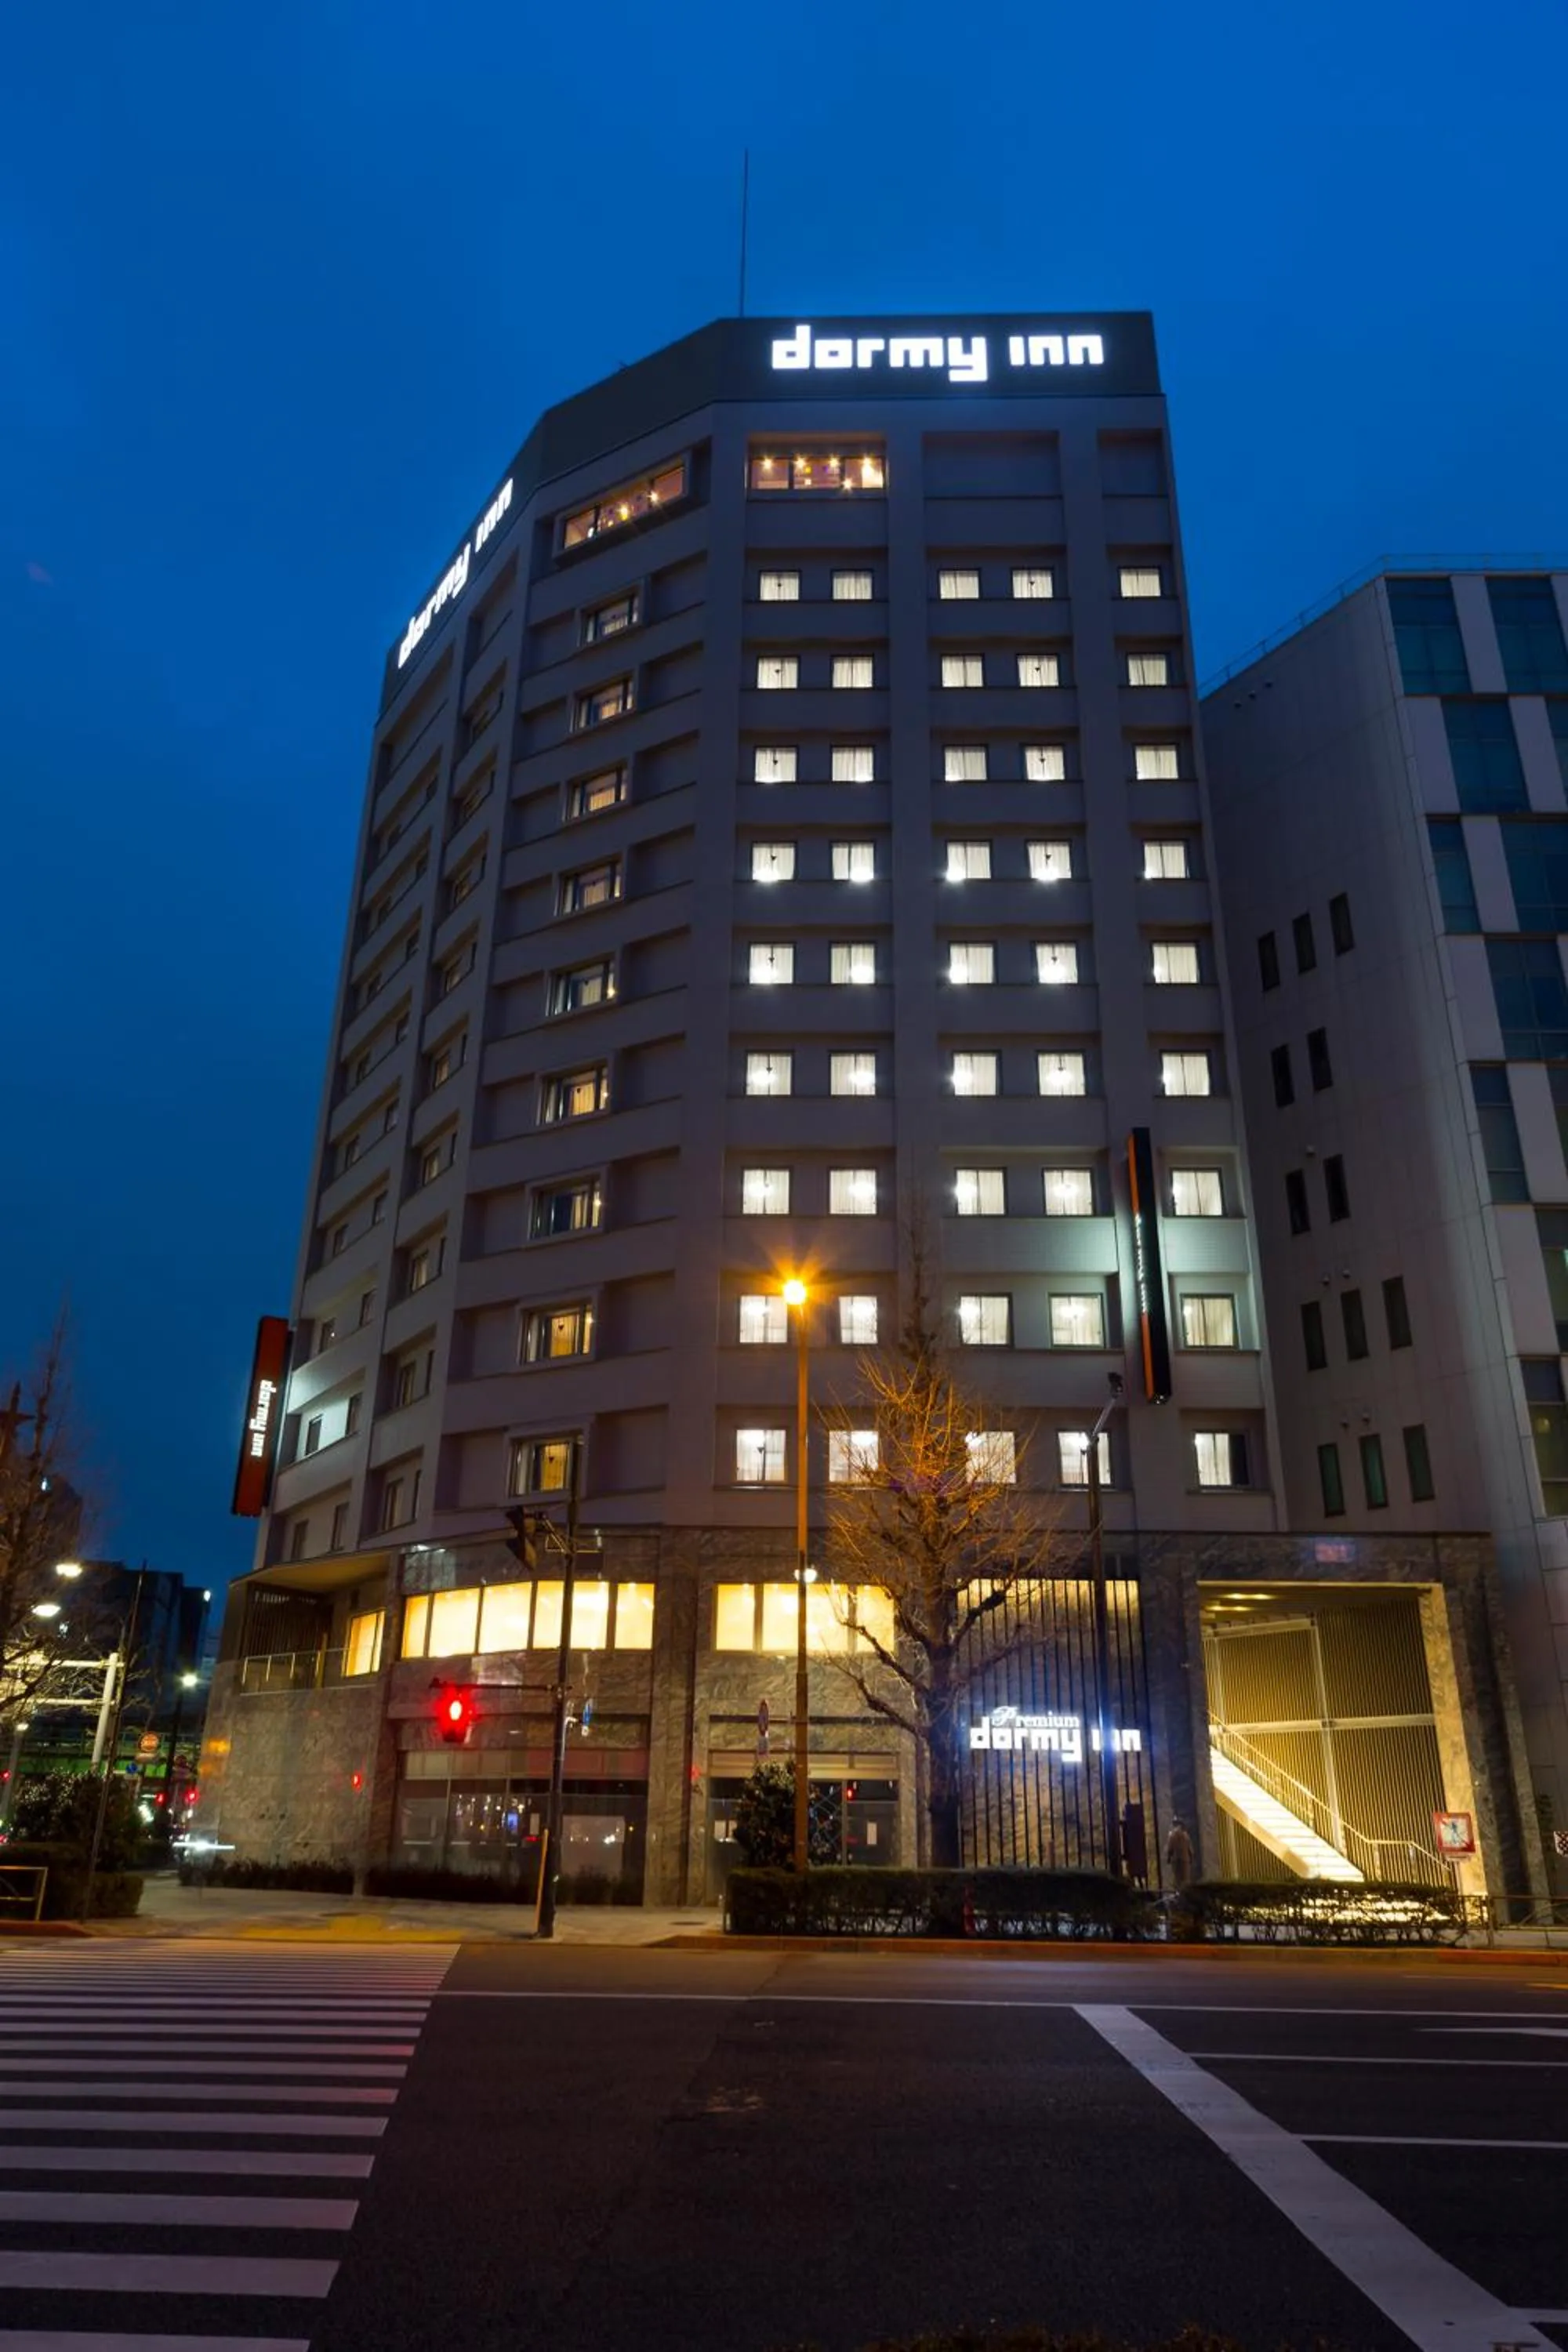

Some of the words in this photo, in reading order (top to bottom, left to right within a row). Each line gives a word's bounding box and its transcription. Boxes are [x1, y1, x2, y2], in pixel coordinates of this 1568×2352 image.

[772, 325, 988, 382] dormy
[1009, 335, 1104, 366] inn
[398, 543, 470, 669] dormy
[475, 478, 514, 553] inn
[249, 1380, 277, 1431] dormy
[250, 1432, 265, 1457] inn
[970, 1717, 1082, 1762] dormy
[992, 1706, 1080, 1727] Premium
